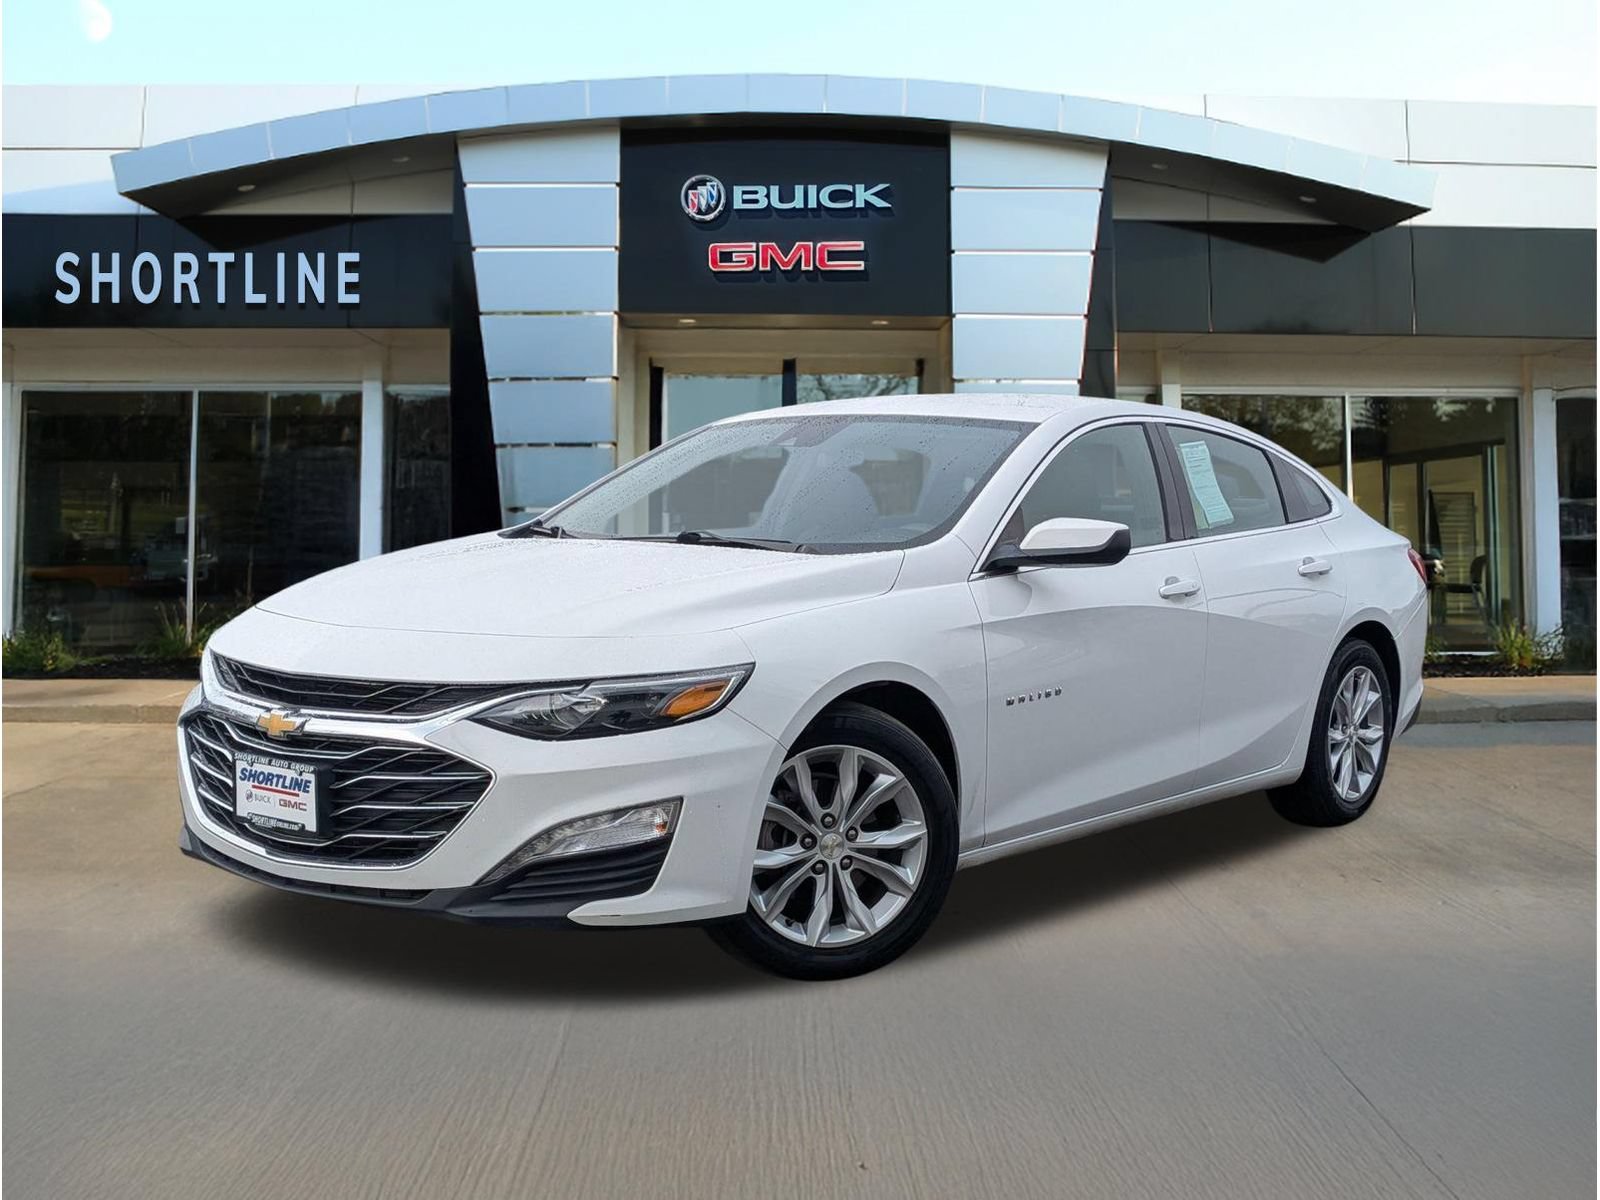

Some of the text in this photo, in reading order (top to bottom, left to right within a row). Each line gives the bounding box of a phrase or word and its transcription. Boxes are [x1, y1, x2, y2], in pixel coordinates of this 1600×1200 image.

[733, 184, 892, 210] BUICK
[708, 241, 865, 271] GMC
[55, 251, 360, 304] SHORTLINE
[234, 753, 314, 772] SHORTLINE AUTO GROUP
[239, 767, 311, 793] SHORTLINE
[278, 798, 307, 811] GMC
